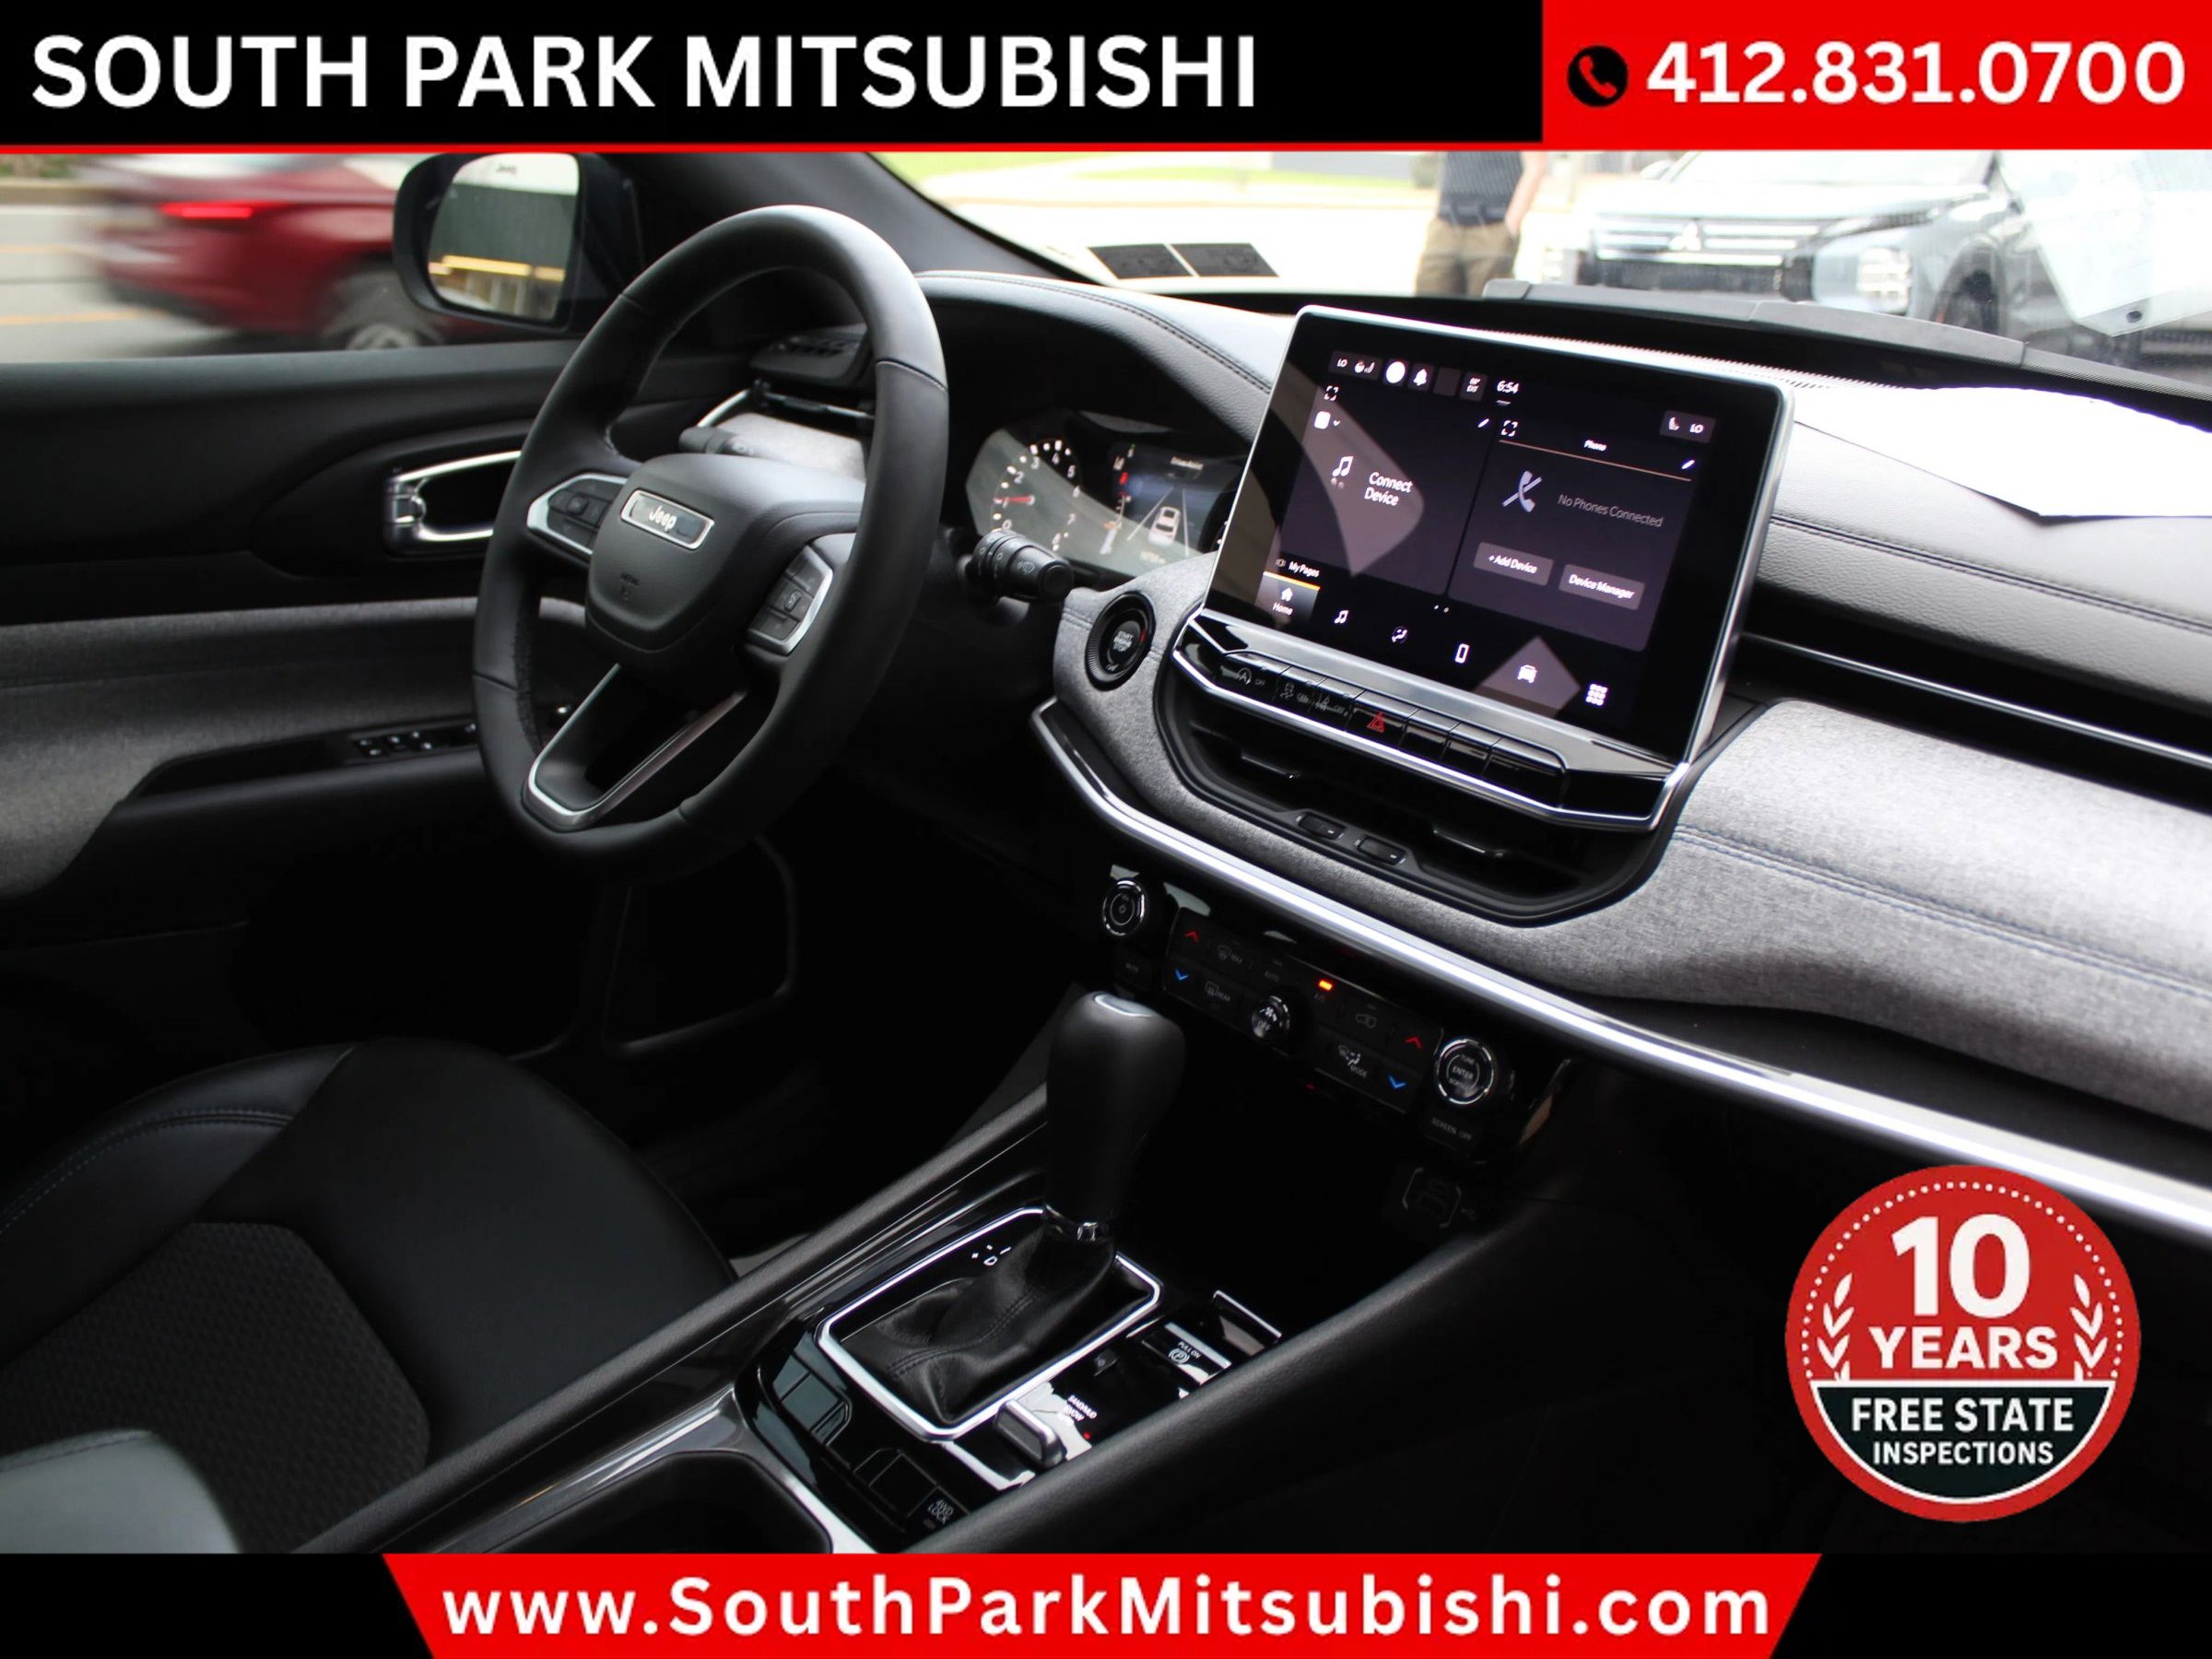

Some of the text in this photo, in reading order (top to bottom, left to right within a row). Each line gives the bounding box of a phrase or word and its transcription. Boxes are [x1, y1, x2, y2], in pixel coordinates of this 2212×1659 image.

[1496, 380, 1520, 394] 6:54
[1030, 456, 1041, 469] 3
[1066, 465, 1076, 477] 5
[1014, 471, 1024, 484] 2
[1369, 471, 1413, 493] Connect
[1364, 487, 1399, 506] Device
[649, 505, 677, 532] Jeep
[1558, 493, 1665, 528] No Phones Connected
[1288, 561, 1320, 578] My Pages
[1494, 555, 1512, 570] Add
[1511, 558, 1537, 574] Device
[1569, 573, 1635, 600] Device Manager
[1273, 602, 1294, 616] Home
[1350, 1064, 1368, 1079] MODE
[1452, 1065, 1475, 1080] ENTER
[1430, 1117, 1473, 1142] SCREEN OFF
